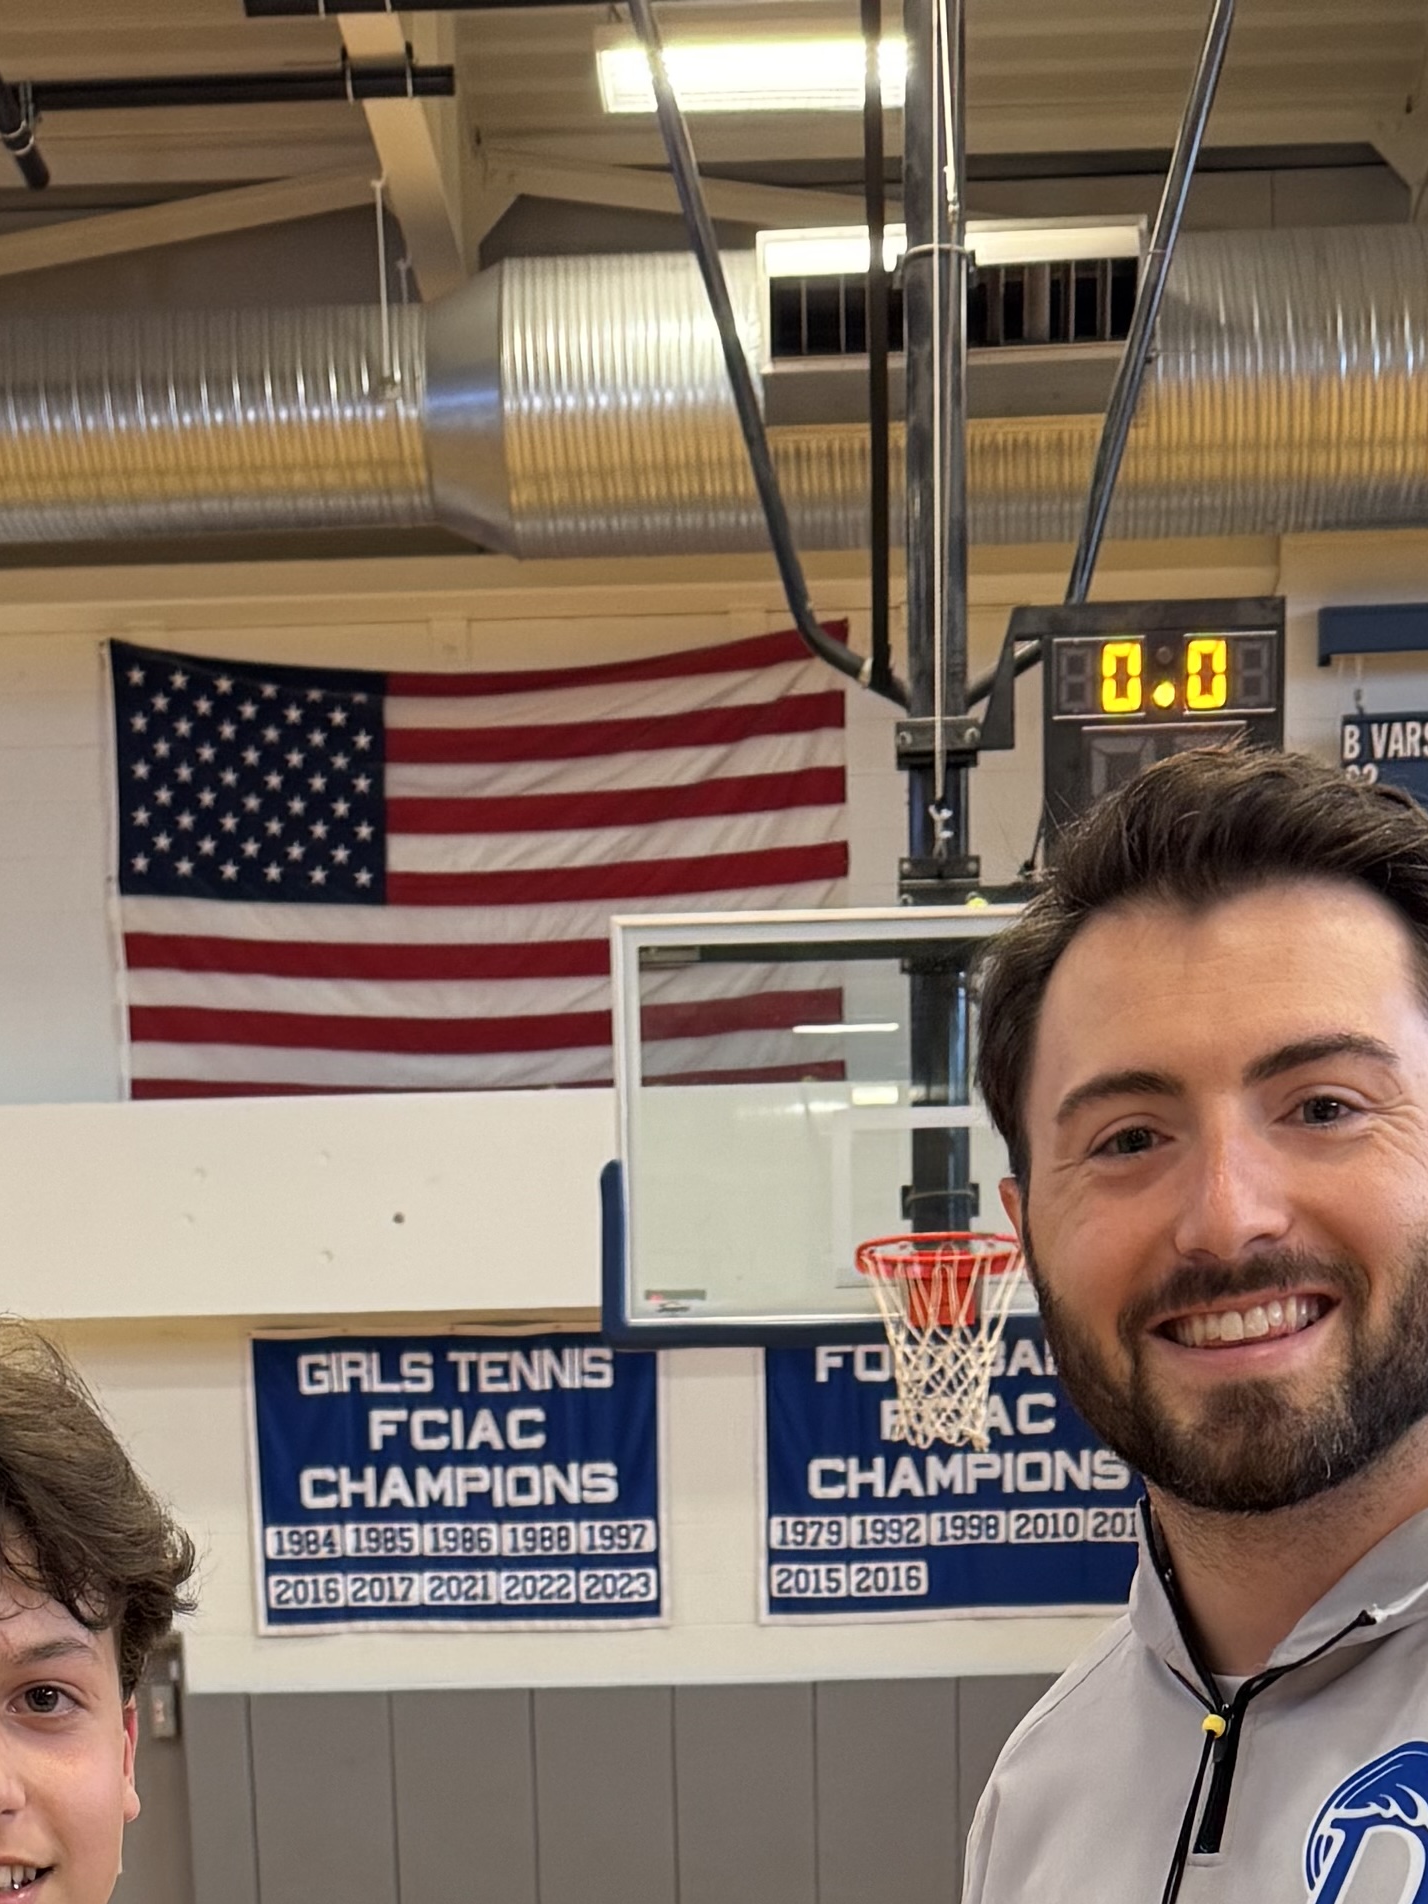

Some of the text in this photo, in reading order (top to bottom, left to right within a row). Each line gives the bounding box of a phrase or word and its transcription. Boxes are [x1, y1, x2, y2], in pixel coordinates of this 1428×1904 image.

[296, 1347, 615, 1395] GIRLS TENNIS
[369, 1406, 546, 1452] FCIAC
[881, 1393, 1057, 1441] FAC
[299, 1460, 619, 1511] CHAMPIONS
[807, 1449, 1131, 1500] CHAMPIONS
[274, 1523, 648, 1556] 1984 1985 1986 1988 1997
[777, 1510, 1137, 1547] 1979 1992 1998 2010 201
[274, 1572, 652, 1605] 2016 2017 2021 2022 2023
[776, 1563, 922, 1595] 2015 2016
